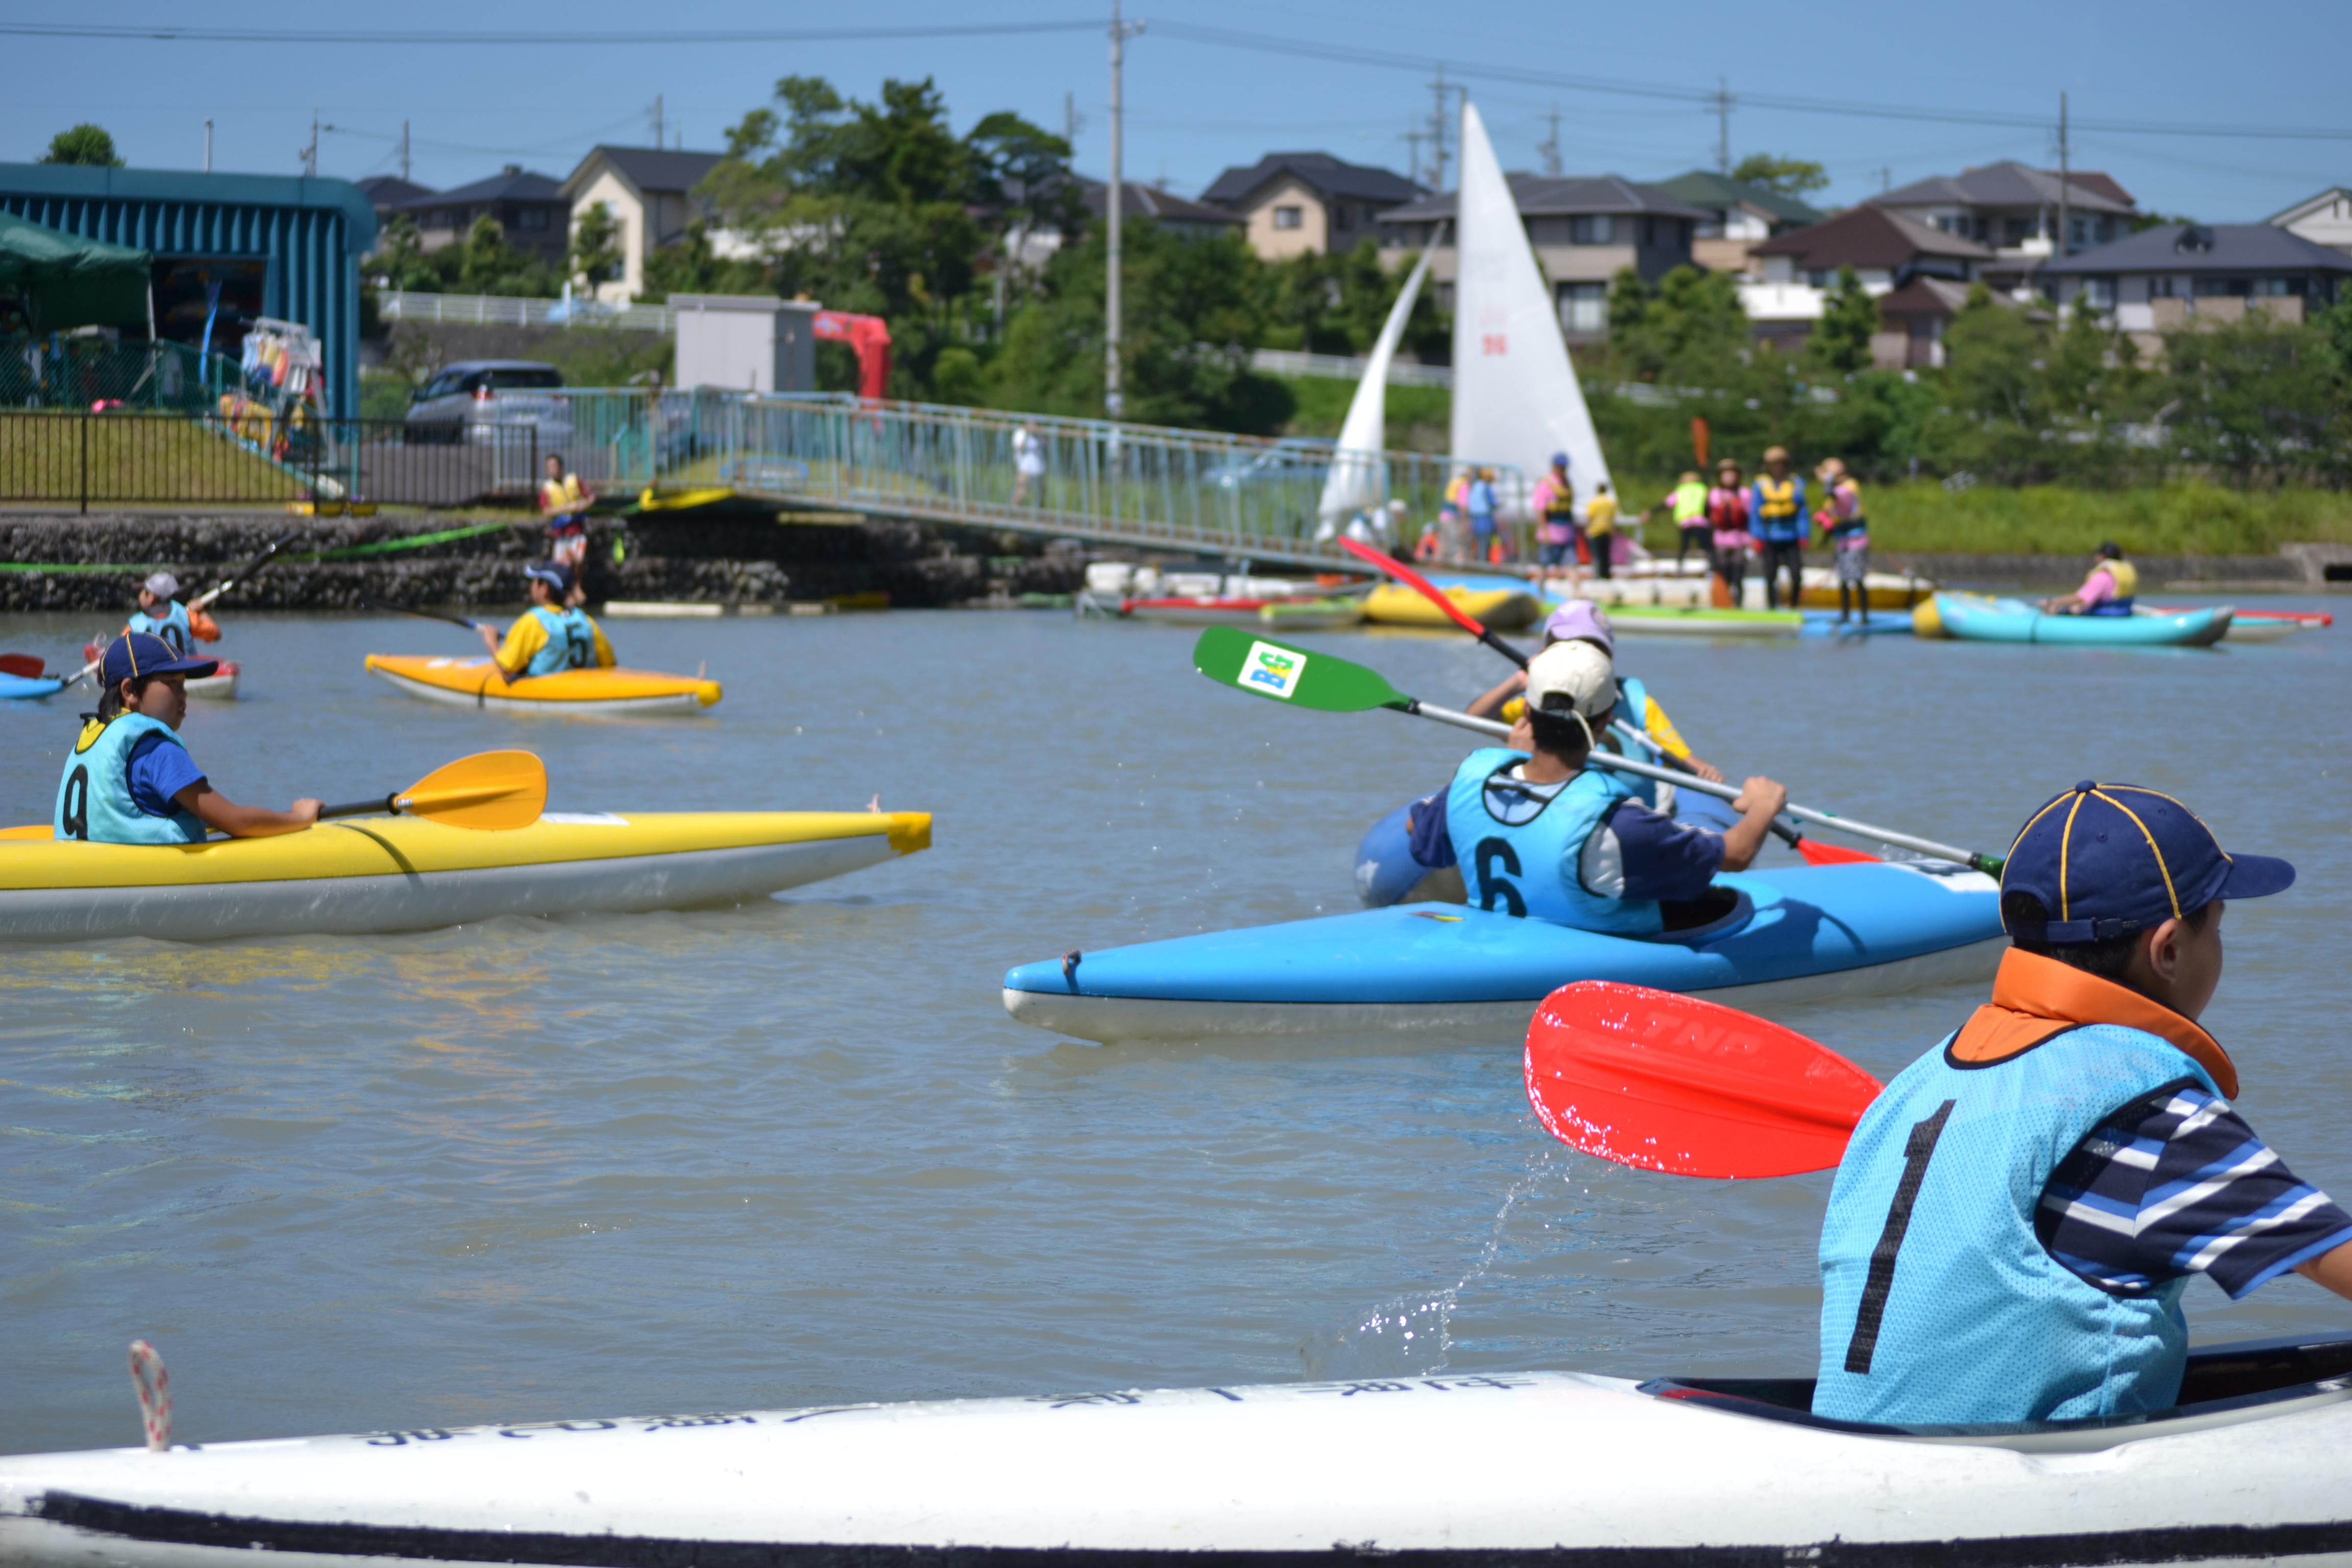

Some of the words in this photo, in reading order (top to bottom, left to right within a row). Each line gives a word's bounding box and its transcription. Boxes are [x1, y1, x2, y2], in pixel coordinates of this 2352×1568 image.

[565, 622, 588, 669] 5
[62, 764, 88, 841] 9
[1475, 836, 1527, 918] 6
[1644, 1011, 1764, 1057] TNP
[1844, 1098, 1956, 1375] 1
